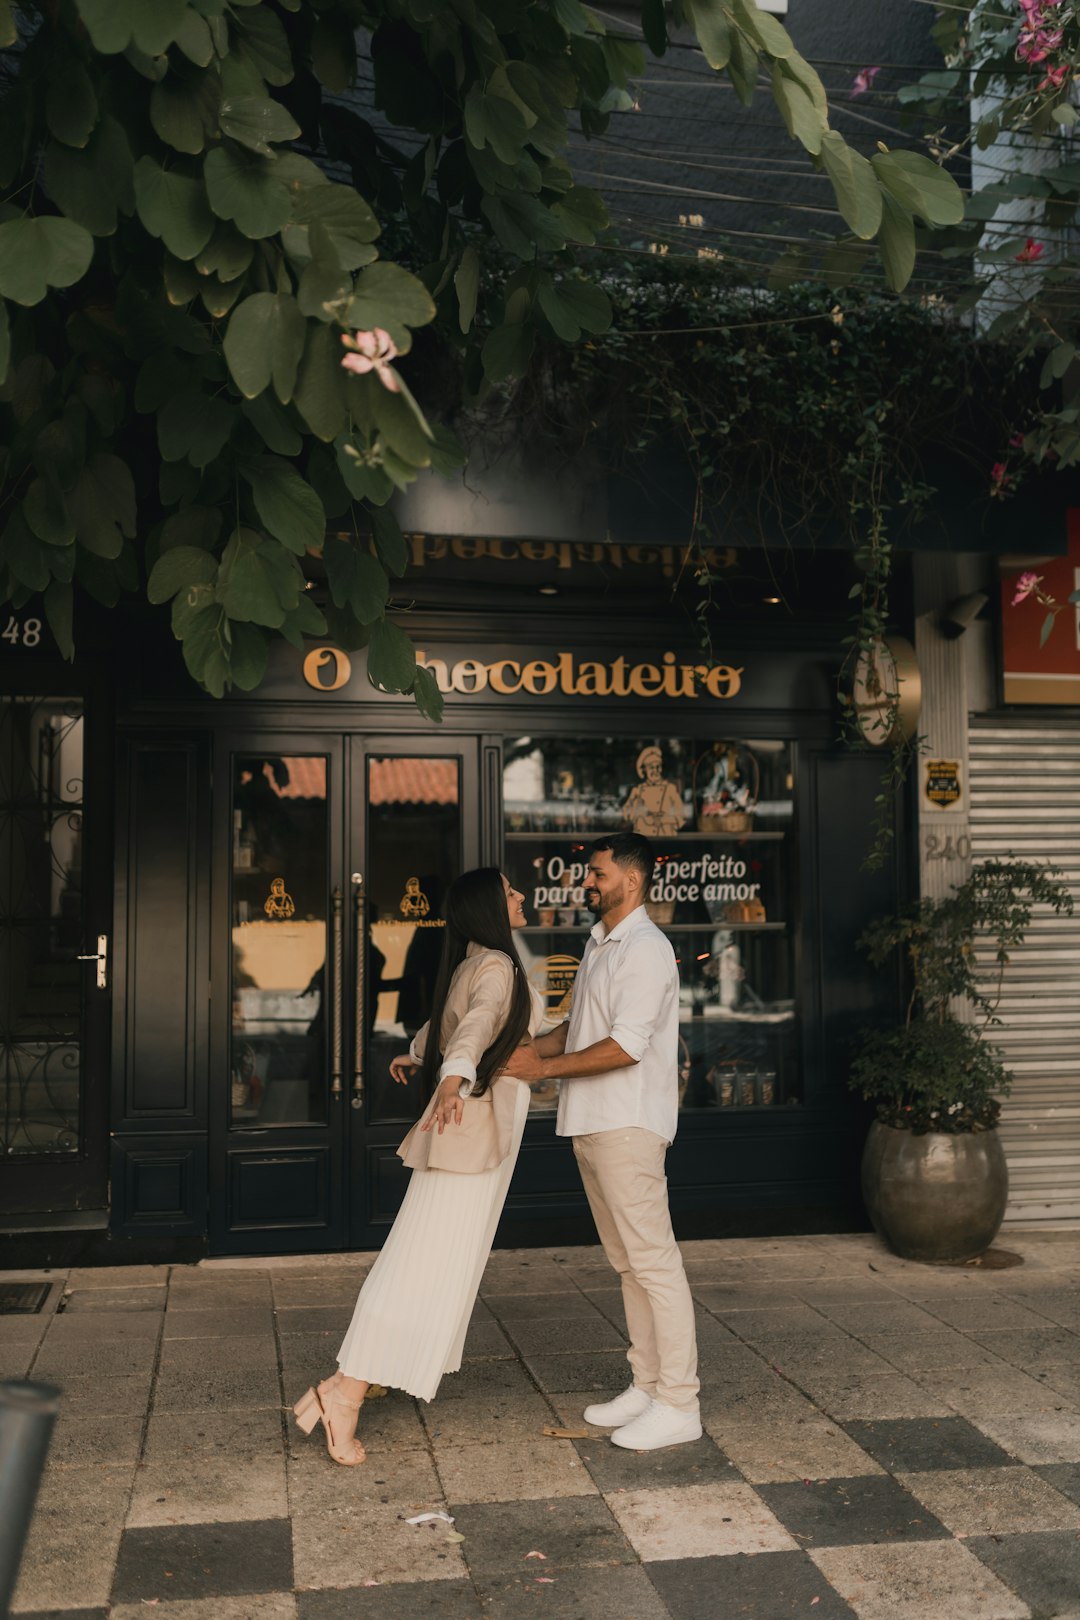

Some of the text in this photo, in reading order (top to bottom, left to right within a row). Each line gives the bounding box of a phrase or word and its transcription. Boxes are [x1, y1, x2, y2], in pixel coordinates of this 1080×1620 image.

[1, 616, 42, 647] 48
[303, 647, 744, 699] O hocolateiro
[547, 856, 565, 880] O
[665, 854, 746, 884] perfeito
[533, 878, 761, 909] para doce amor
